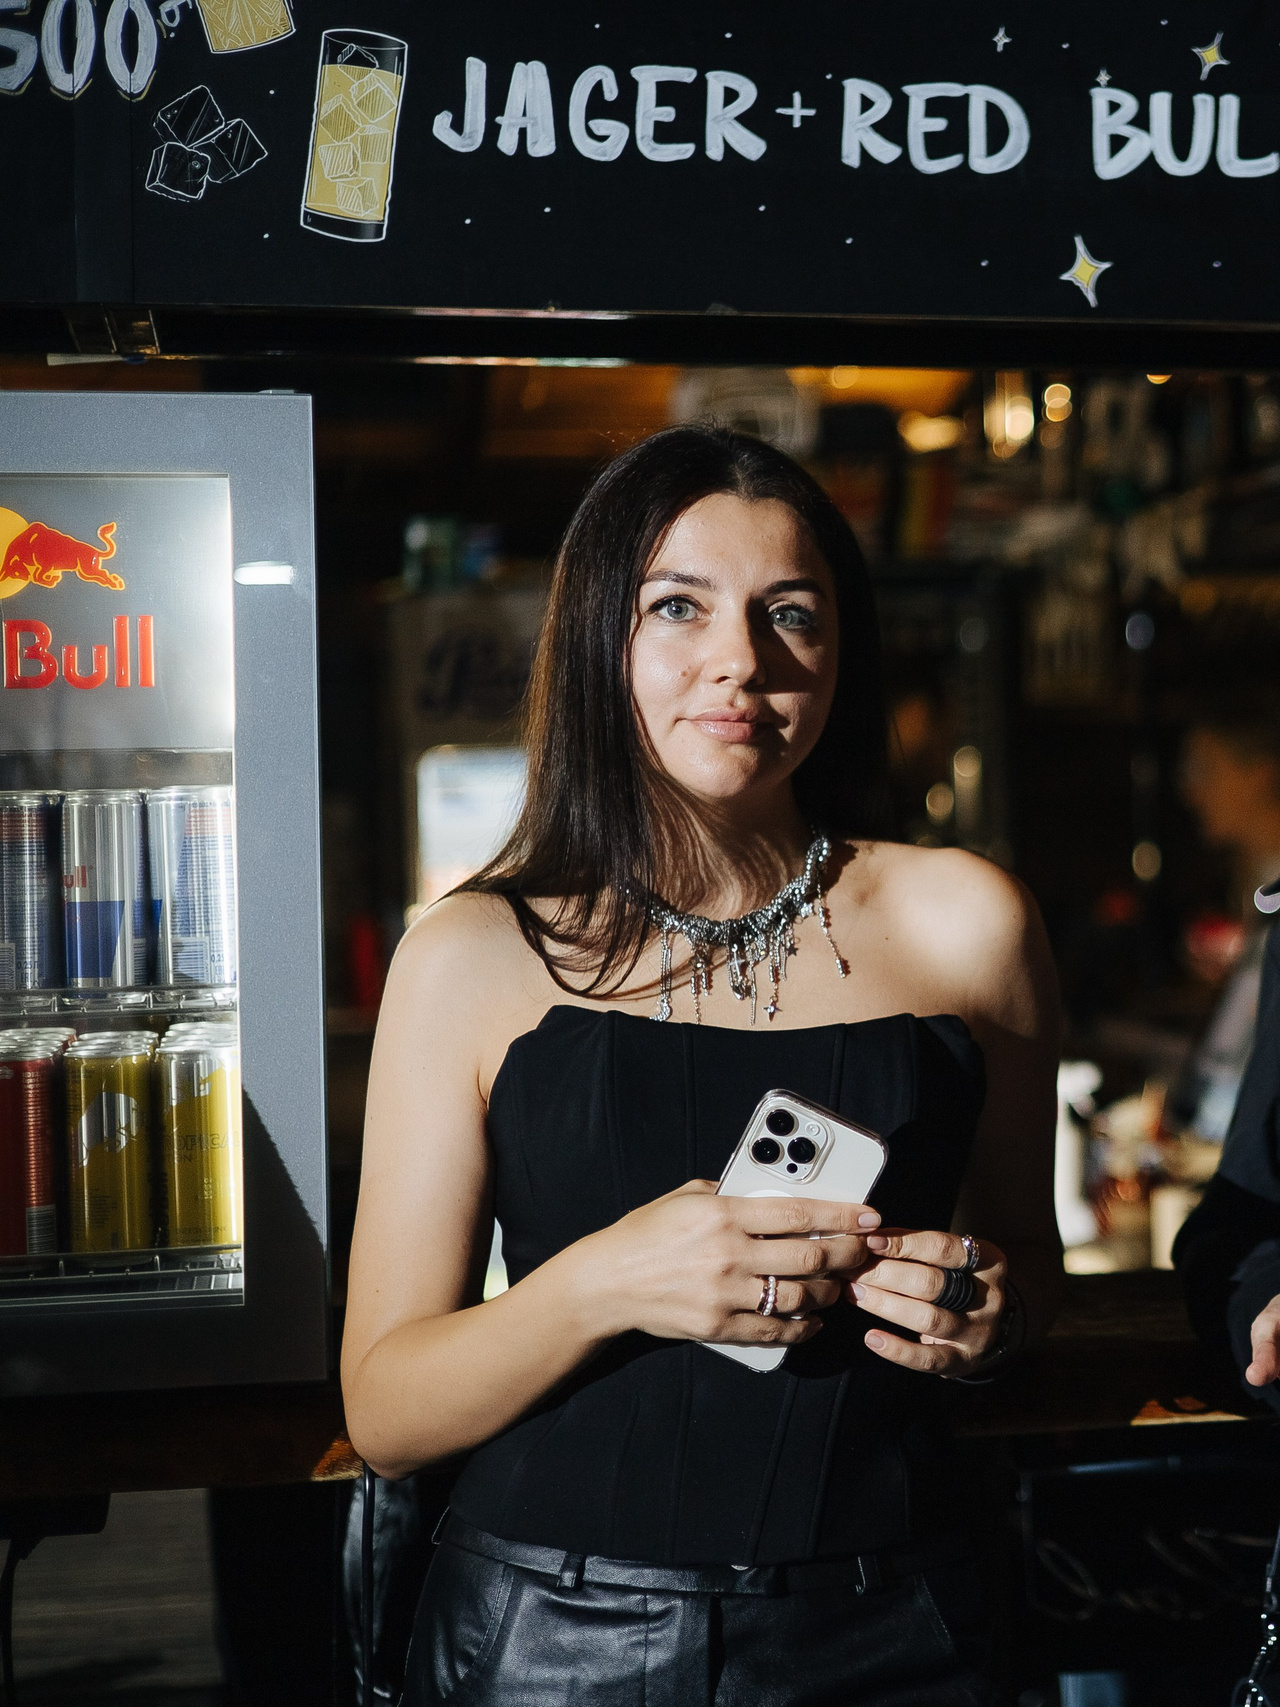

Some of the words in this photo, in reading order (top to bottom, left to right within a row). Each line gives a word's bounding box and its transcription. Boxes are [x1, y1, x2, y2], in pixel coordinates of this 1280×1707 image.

[842, 78, 1030, 174] RED
[3, 614, 155, 690] Bull
[62, 865, 87, 888] ull
